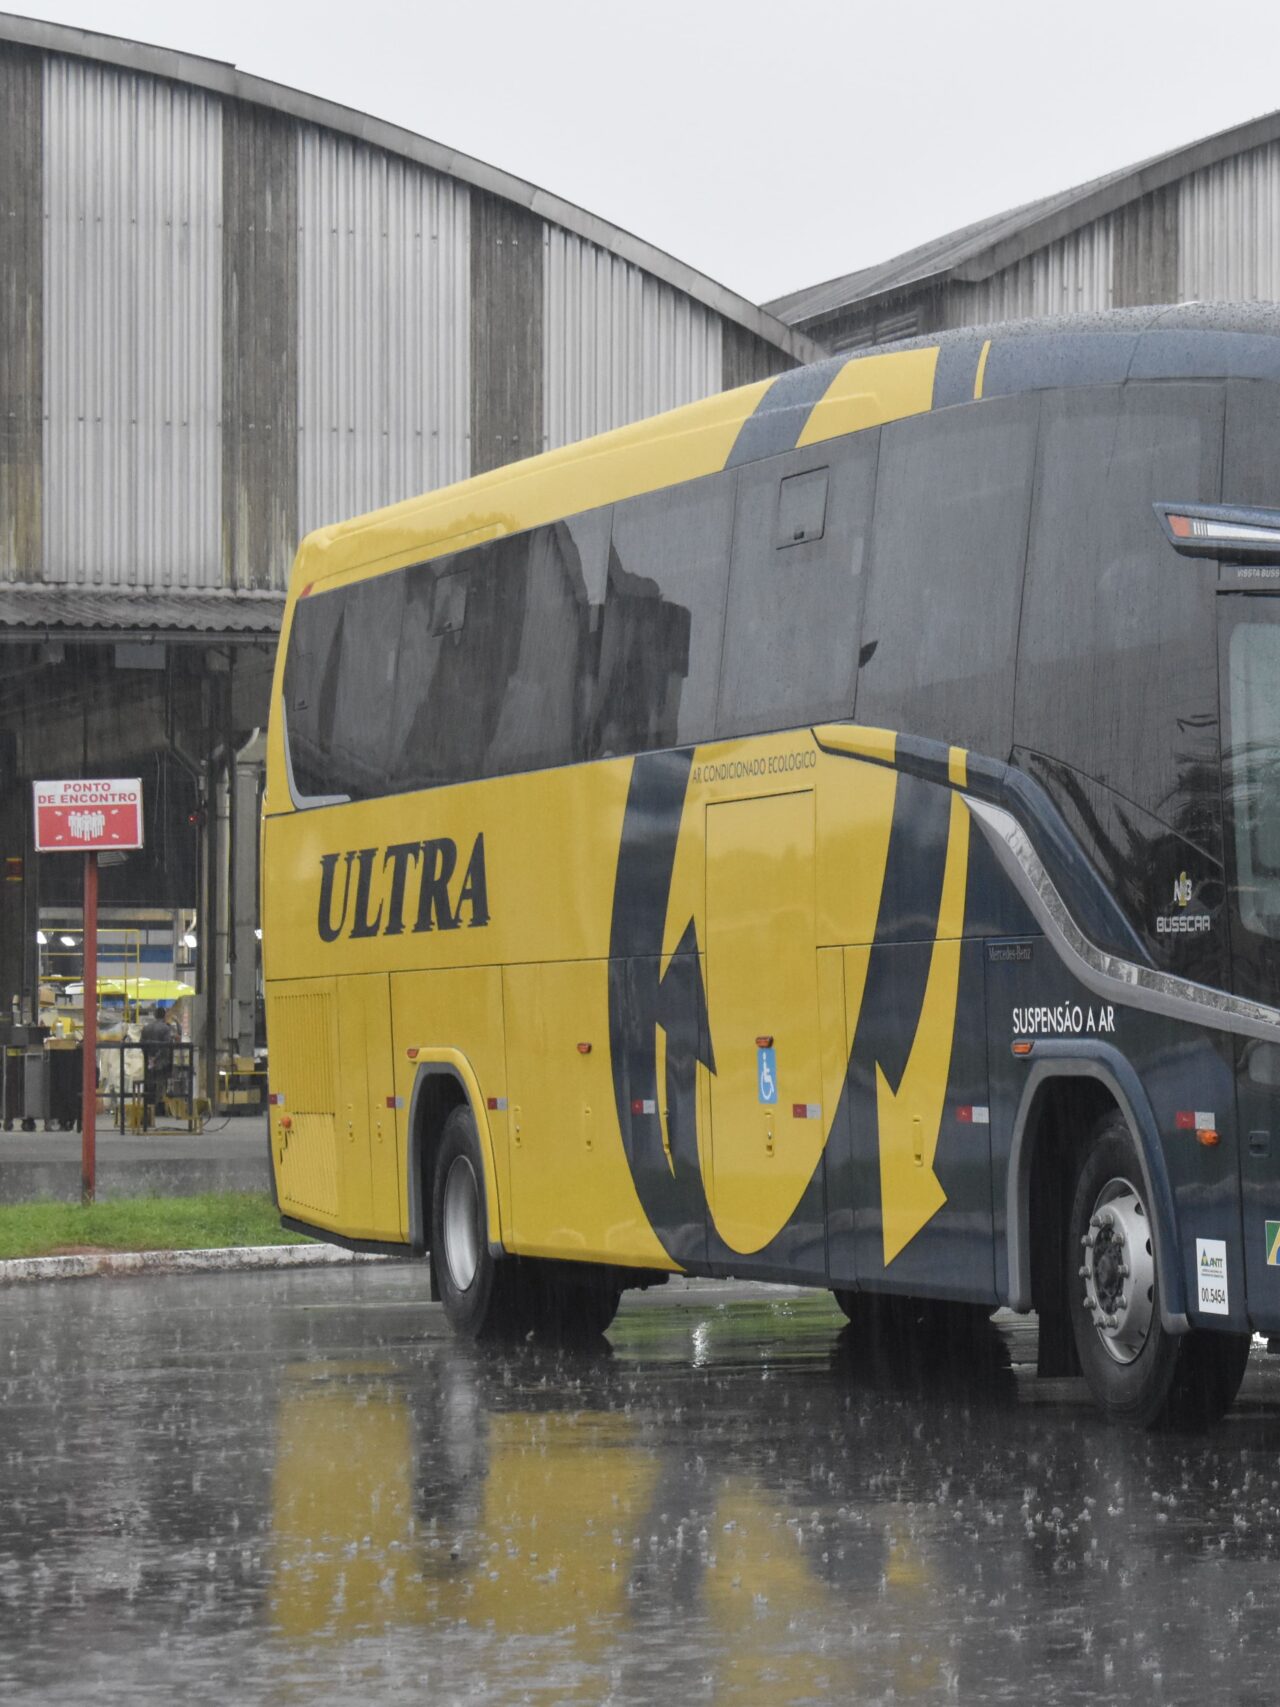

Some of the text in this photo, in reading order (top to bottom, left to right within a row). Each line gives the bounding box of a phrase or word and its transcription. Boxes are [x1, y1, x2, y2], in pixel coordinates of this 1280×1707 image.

[704, 758, 766, 782] CONDICIONADO
[63, 783, 111, 793] PONTO
[38, 793, 138, 804] DE ENCONTRO
[318, 832, 491, 943] ULTRA
[1156, 915, 1211, 932] BUSSCAR
[1012, 1000, 1116, 1034] SUSPENSÃO A AR
[1209, 1257, 1223, 1268] ANTT
[1201, 1287, 1226, 1304] 00.5454
